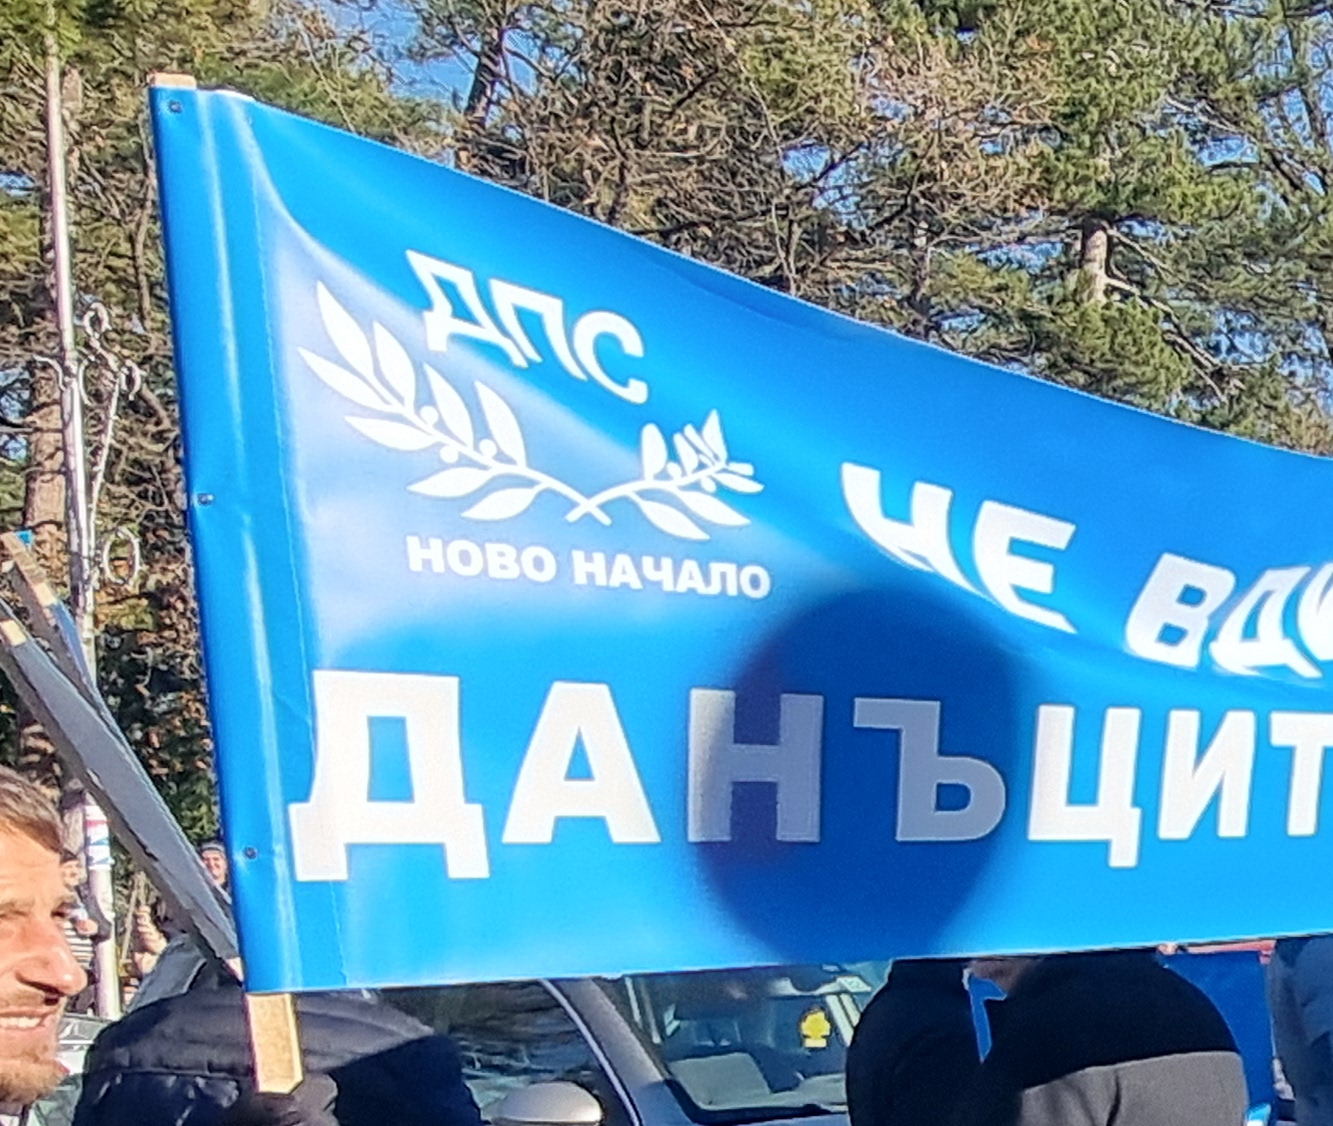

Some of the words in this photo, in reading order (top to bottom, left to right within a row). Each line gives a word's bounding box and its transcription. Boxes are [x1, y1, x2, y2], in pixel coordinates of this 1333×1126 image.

[406, 250, 649, 404] ДПС
[406, 535, 557, 584] НОВО
[572, 549, 773, 600] НАЧАЛО
[841, 462, 1076, 634] НЕ
